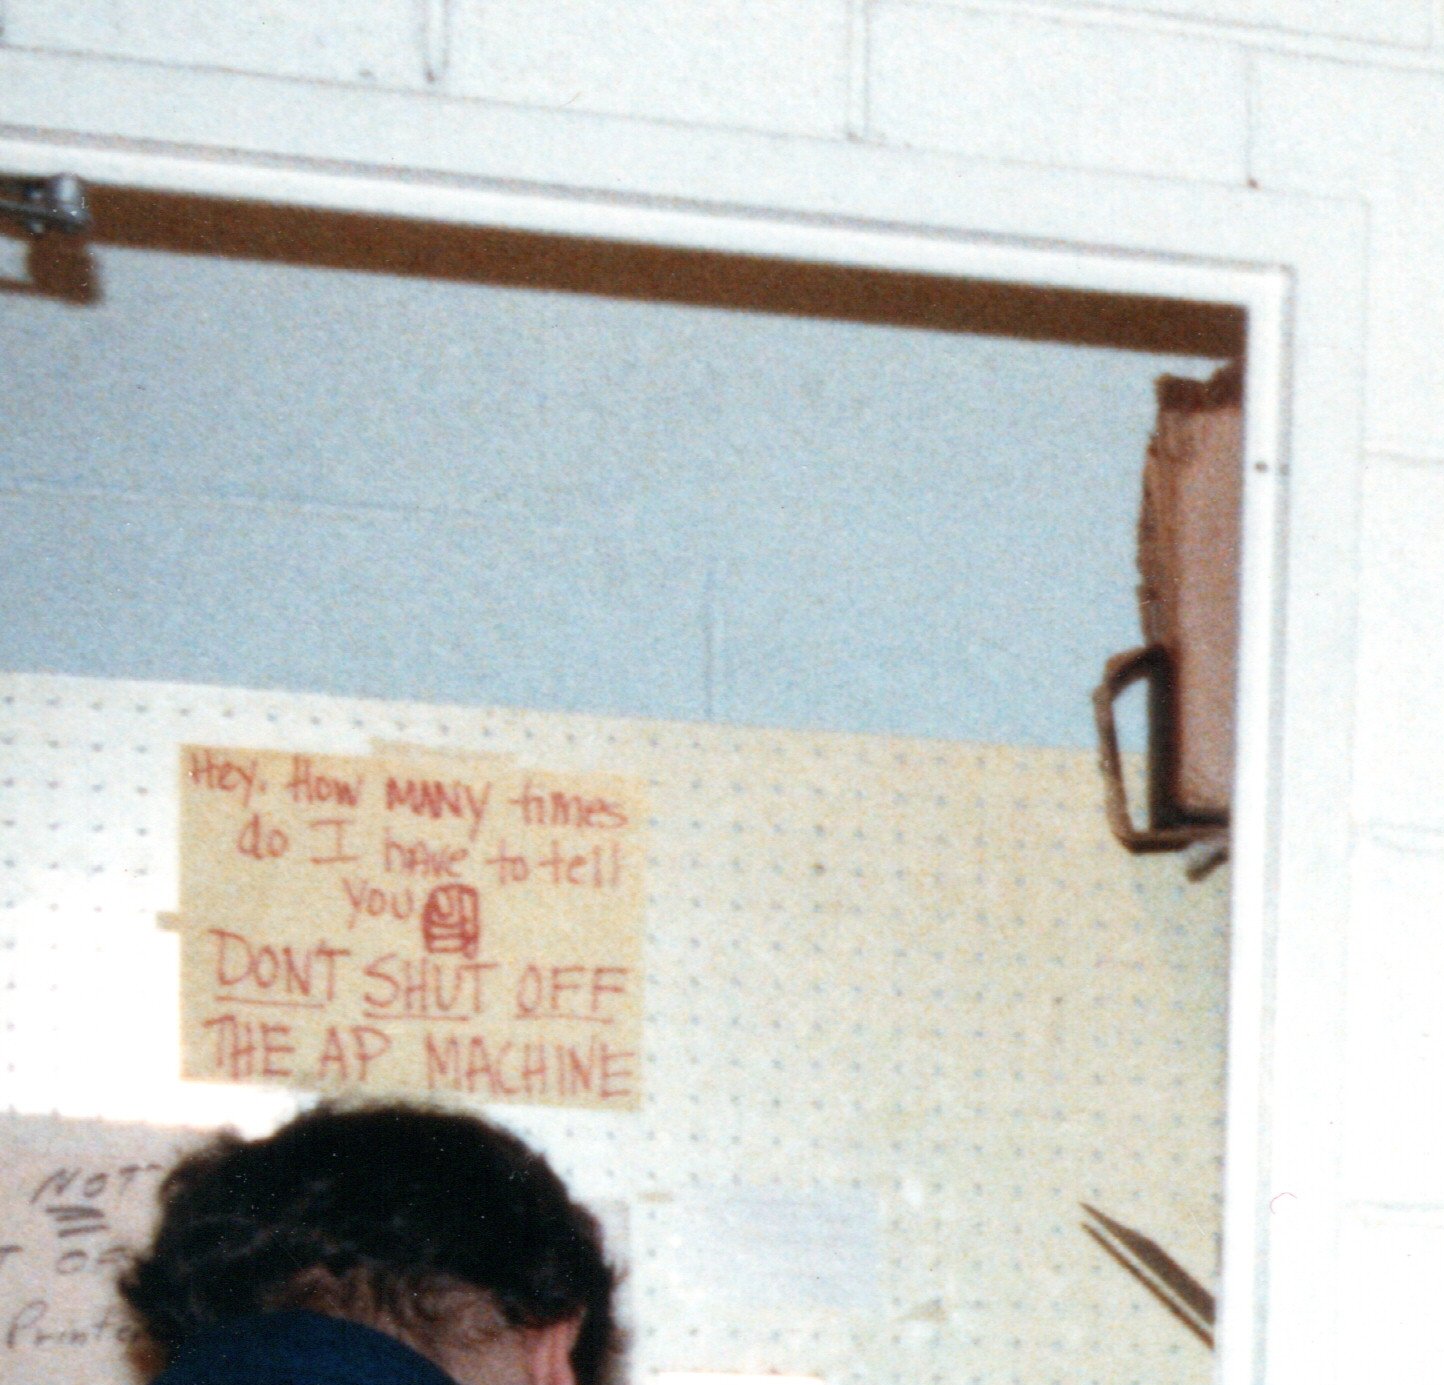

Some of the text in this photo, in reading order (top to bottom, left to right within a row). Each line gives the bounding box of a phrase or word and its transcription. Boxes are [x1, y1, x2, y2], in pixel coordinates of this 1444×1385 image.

[284, 753, 365, 807] How
[385, 776, 492, 842] MANY
[508, 779, 630, 829] times
[237, 813, 290, 860] do
[307, 818, 360, 864] I
[485, 838, 530, 886] to
[537, 840, 624, 889] tell
[362, 953, 500, 1013] SHUT
[515, 965, 630, 1013] OFF
[201, 1014, 636, 1099] THE AP MACHINE
